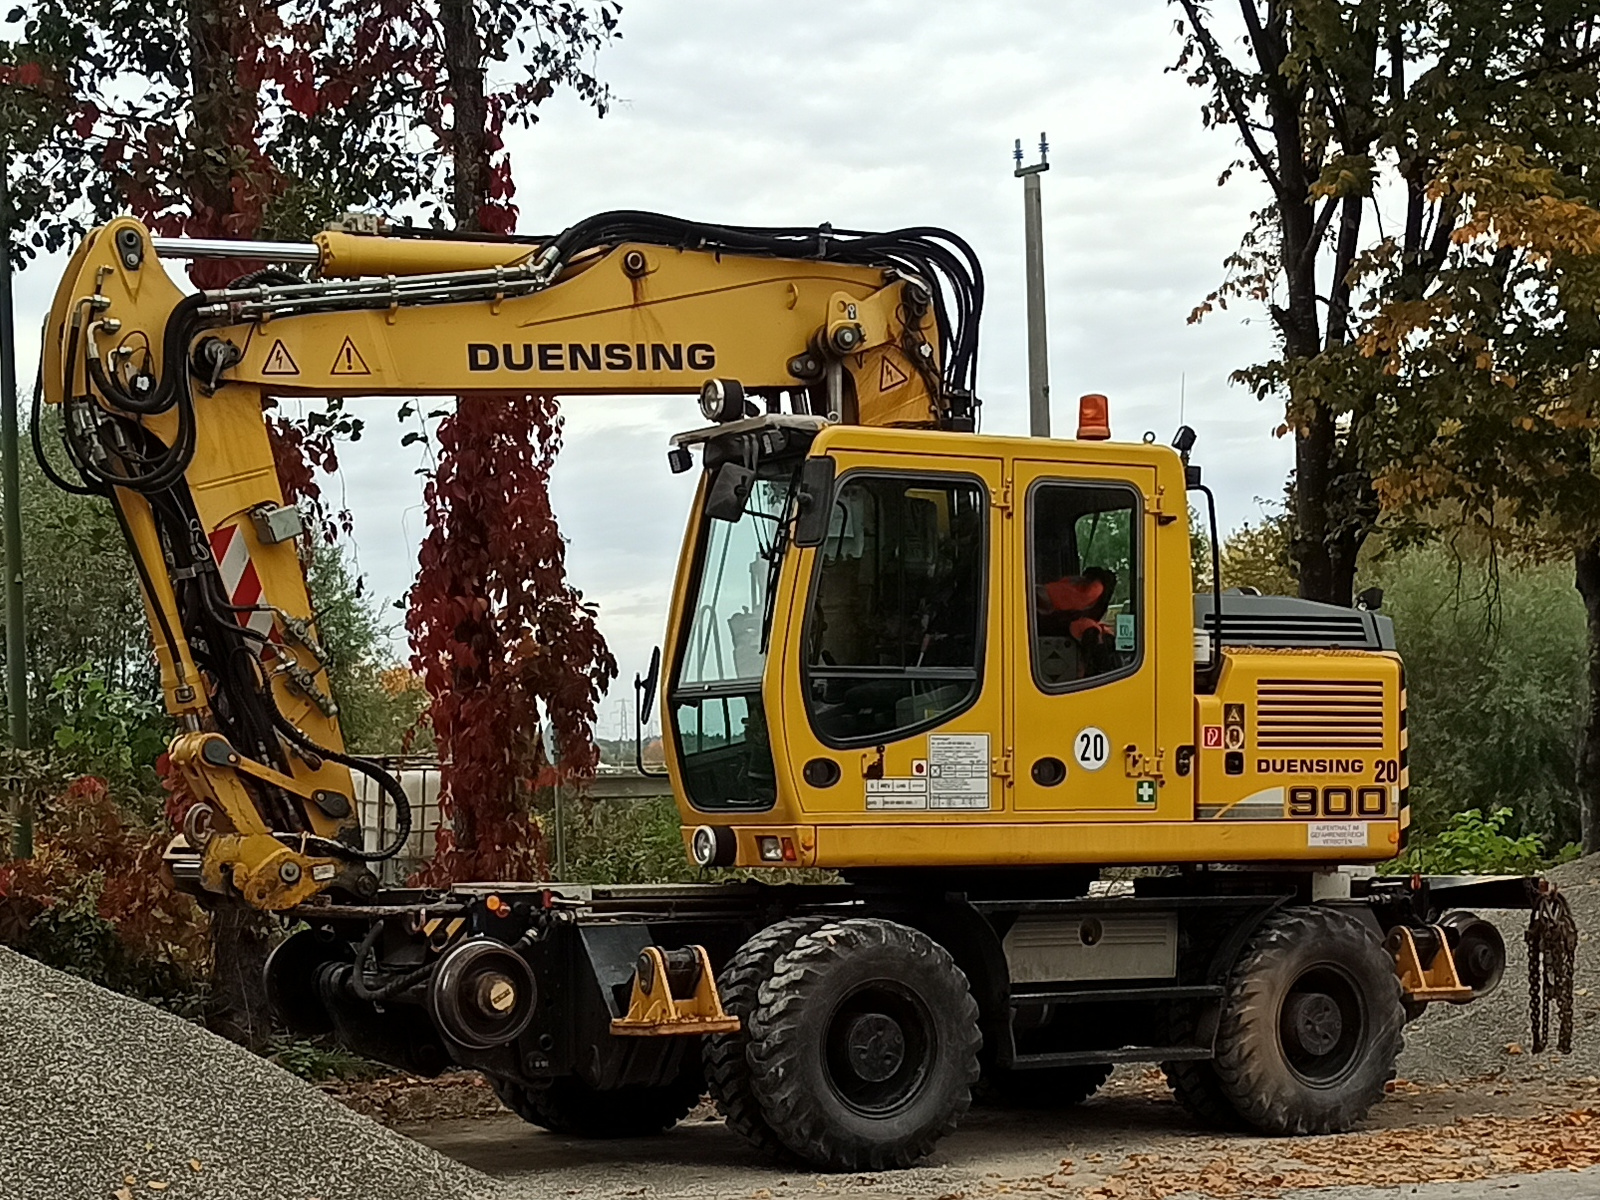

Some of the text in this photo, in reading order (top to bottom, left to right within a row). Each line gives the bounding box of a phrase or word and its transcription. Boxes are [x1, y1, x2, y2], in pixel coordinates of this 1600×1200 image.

[467, 343, 716, 371] DUENSING
[1080, 733, 1104, 762] 20
[1257, 759, 1364, 773] DUENSING
[1374, 759, 1398, 783] 20
[1288, 785, 1388, 818] 900
